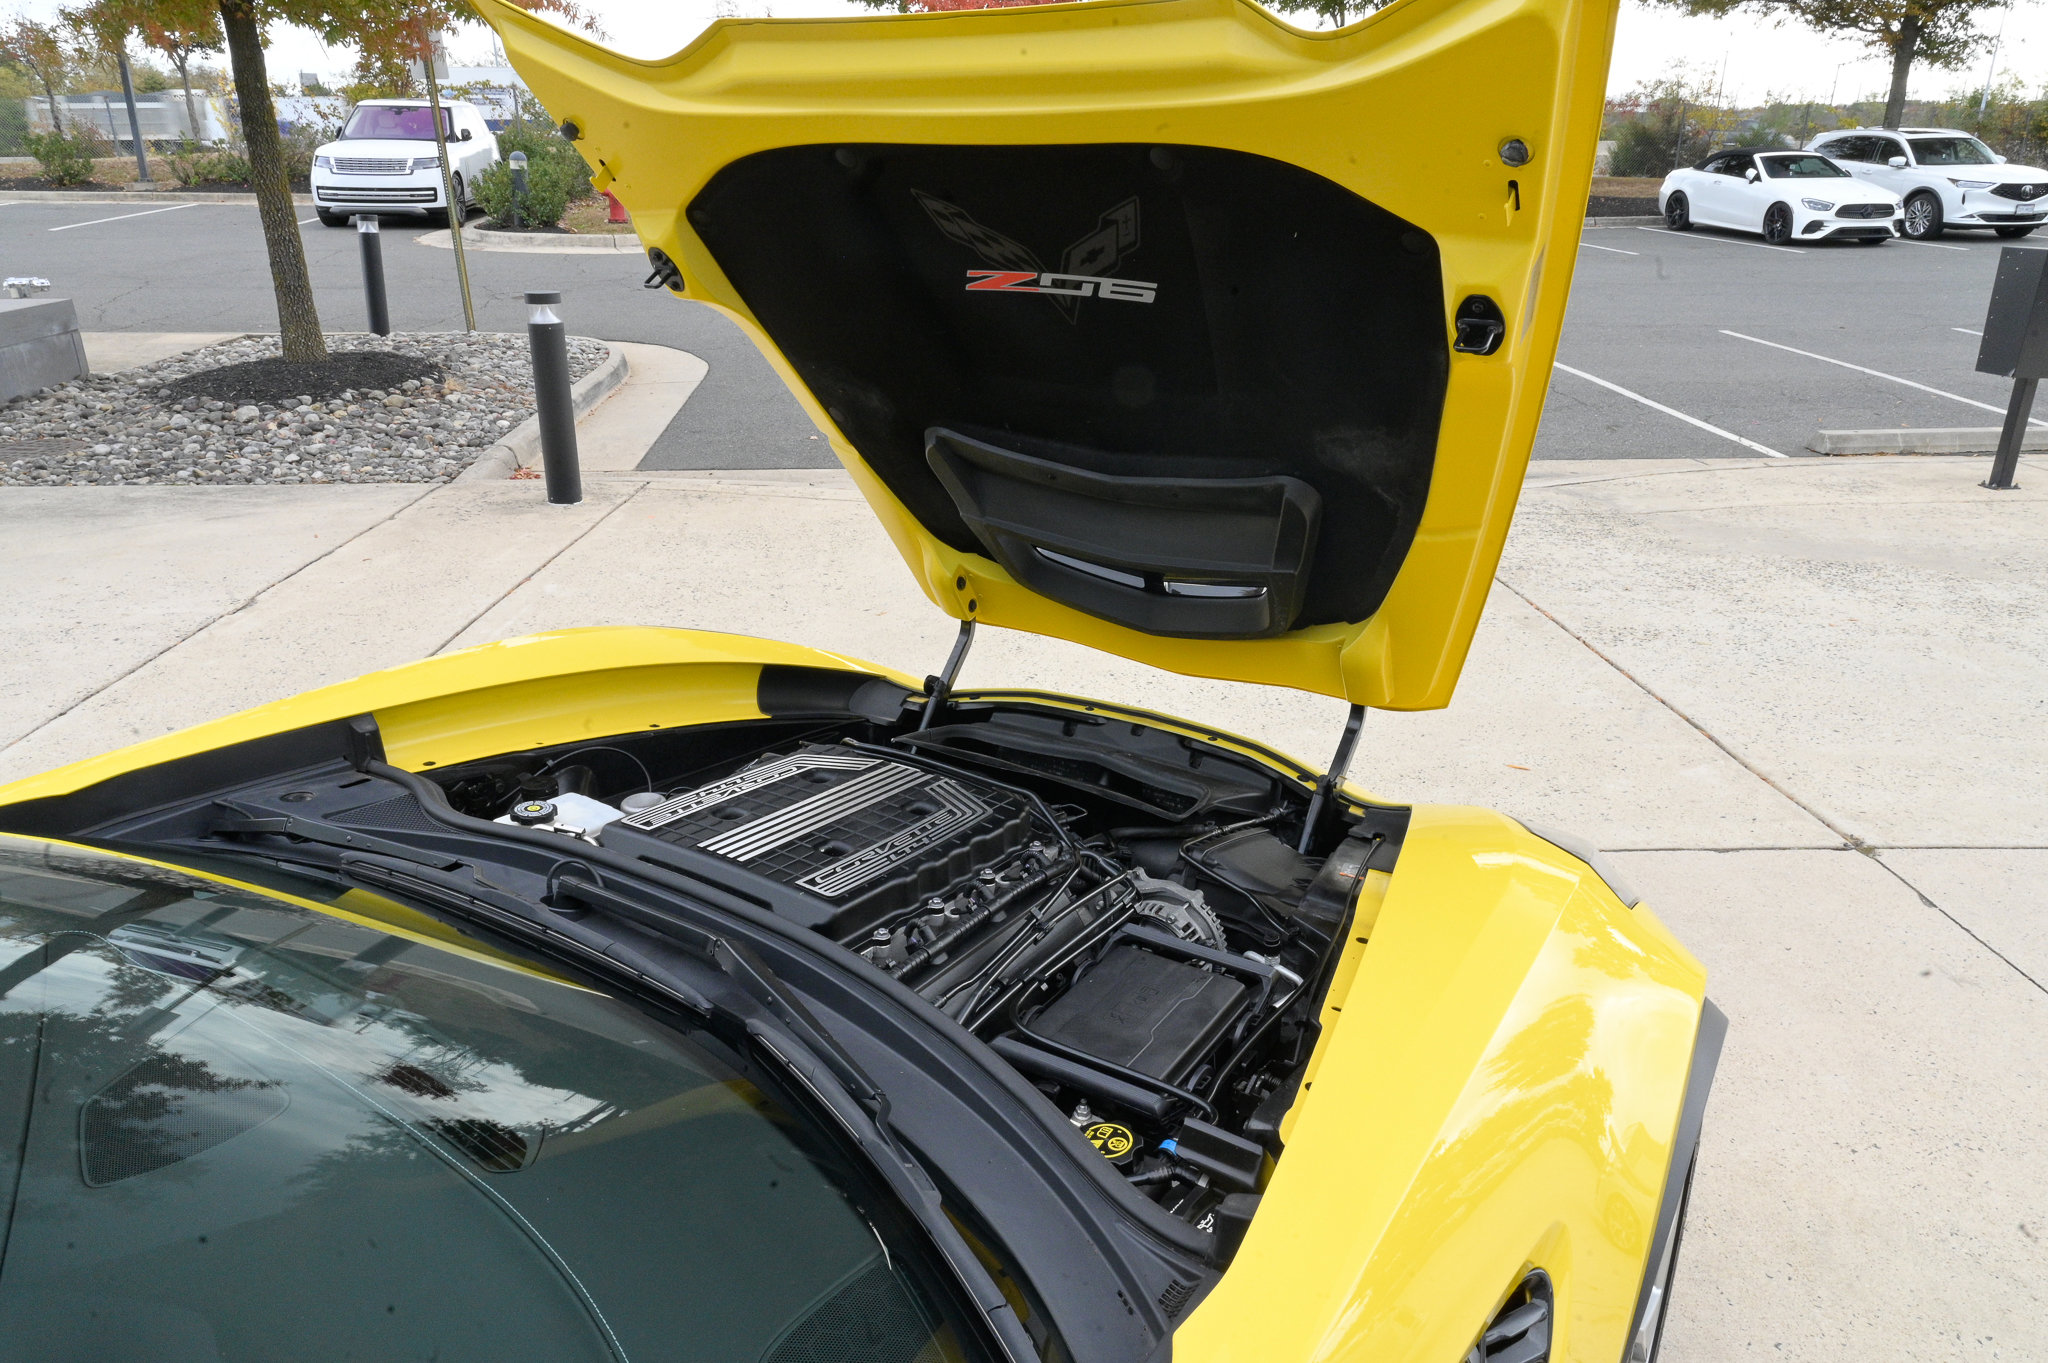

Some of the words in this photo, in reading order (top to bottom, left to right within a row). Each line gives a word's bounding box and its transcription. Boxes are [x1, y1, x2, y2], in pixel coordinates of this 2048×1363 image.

[966, 270, 1157, 303] Z06
[815, 811, 952, 884] CORVETTE
[890, 837, 931, 862] LT4
